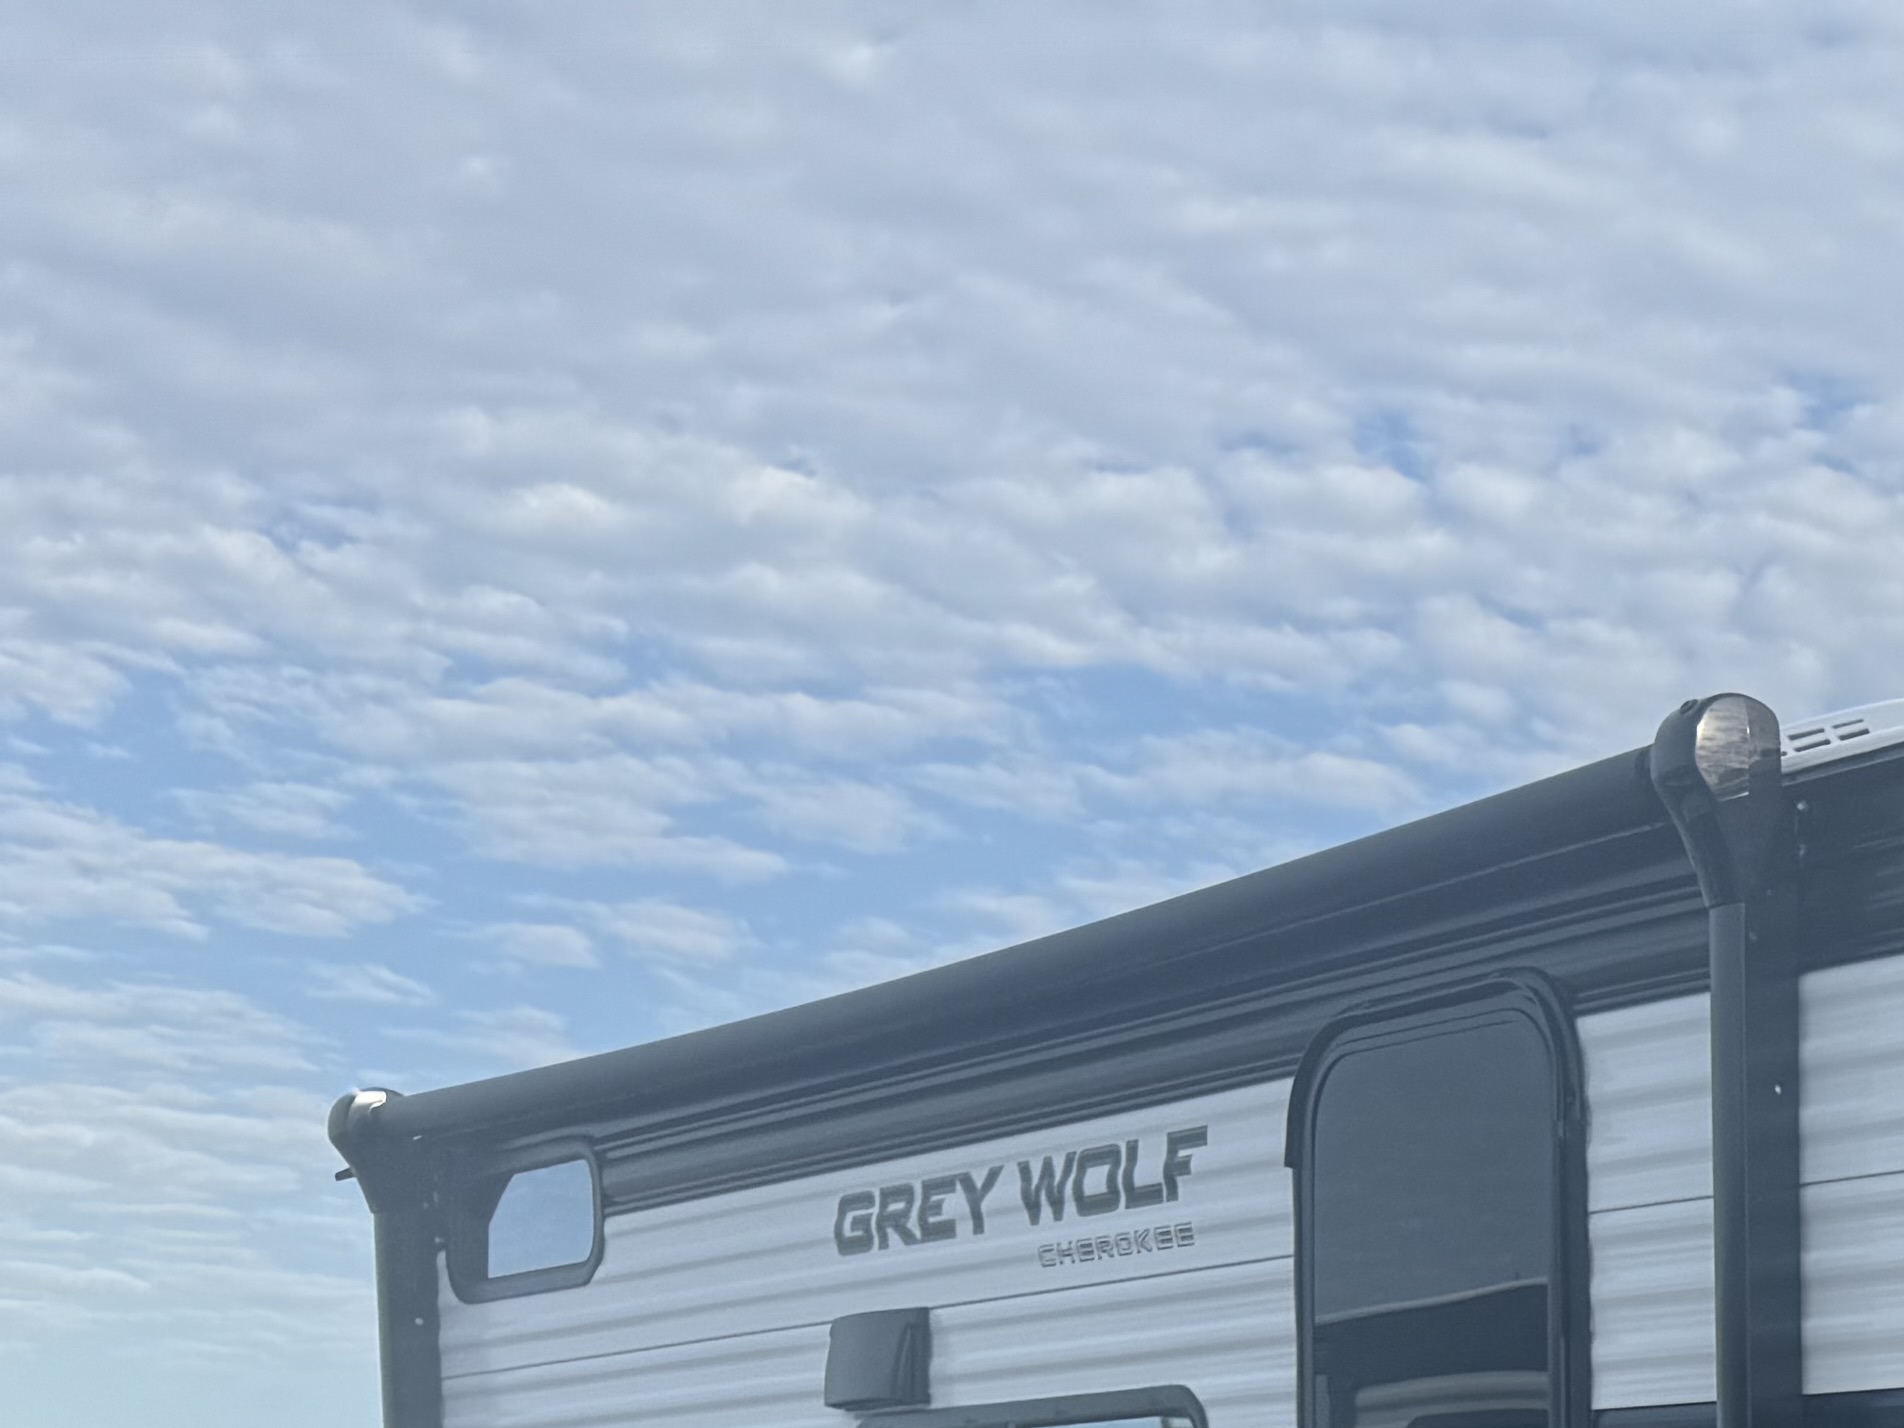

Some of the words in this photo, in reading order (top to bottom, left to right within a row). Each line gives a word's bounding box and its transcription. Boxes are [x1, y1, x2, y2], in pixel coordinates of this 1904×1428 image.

[833, 1164, 1005, 1257] GREY
[1016, 1124, 1209, 1227] WOLF
[1037, 1221, 1196, 1269] CHEROKEE
